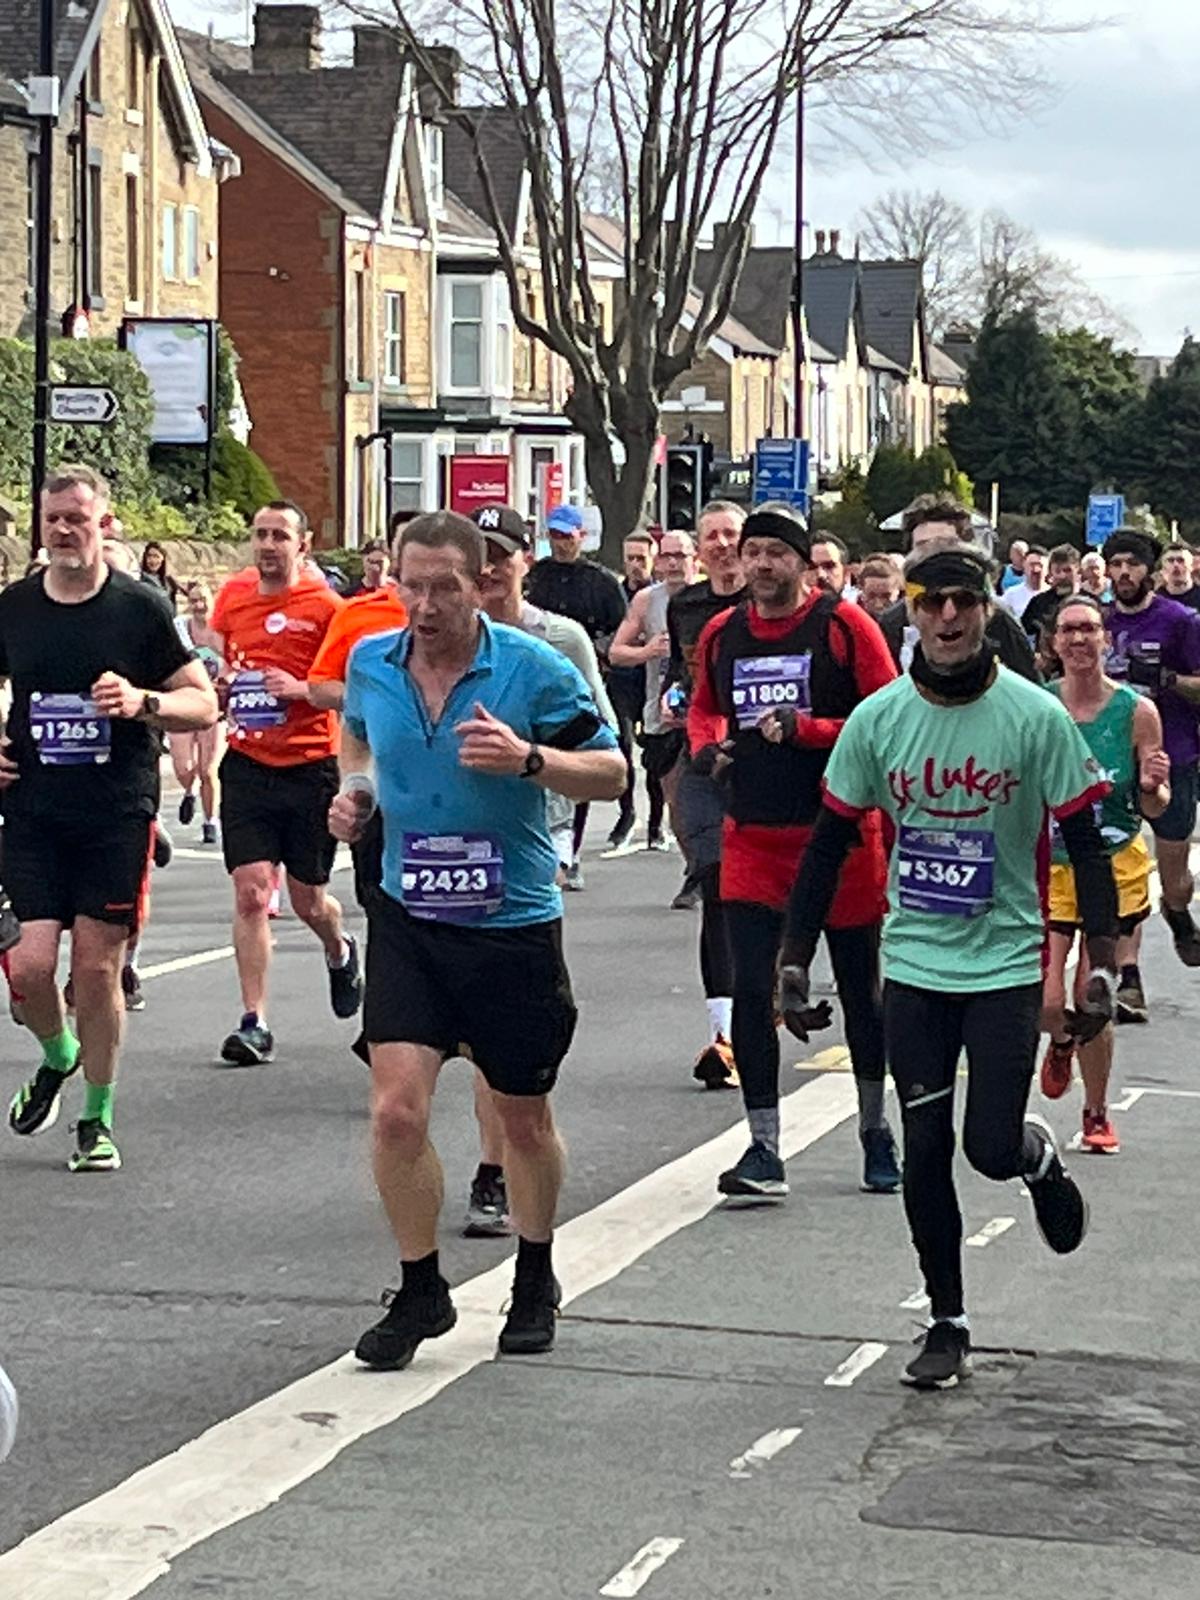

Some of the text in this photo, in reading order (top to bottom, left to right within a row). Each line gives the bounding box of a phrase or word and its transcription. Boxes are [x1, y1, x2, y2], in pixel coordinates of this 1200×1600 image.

[748, 682, 799, 704] 1800
[46, 721, 100, 740] 1265
[923, 754, 1021, 806] Luke's
[419, 868, 488, 893] 2423
[914, 860, 978, 887] 5367
